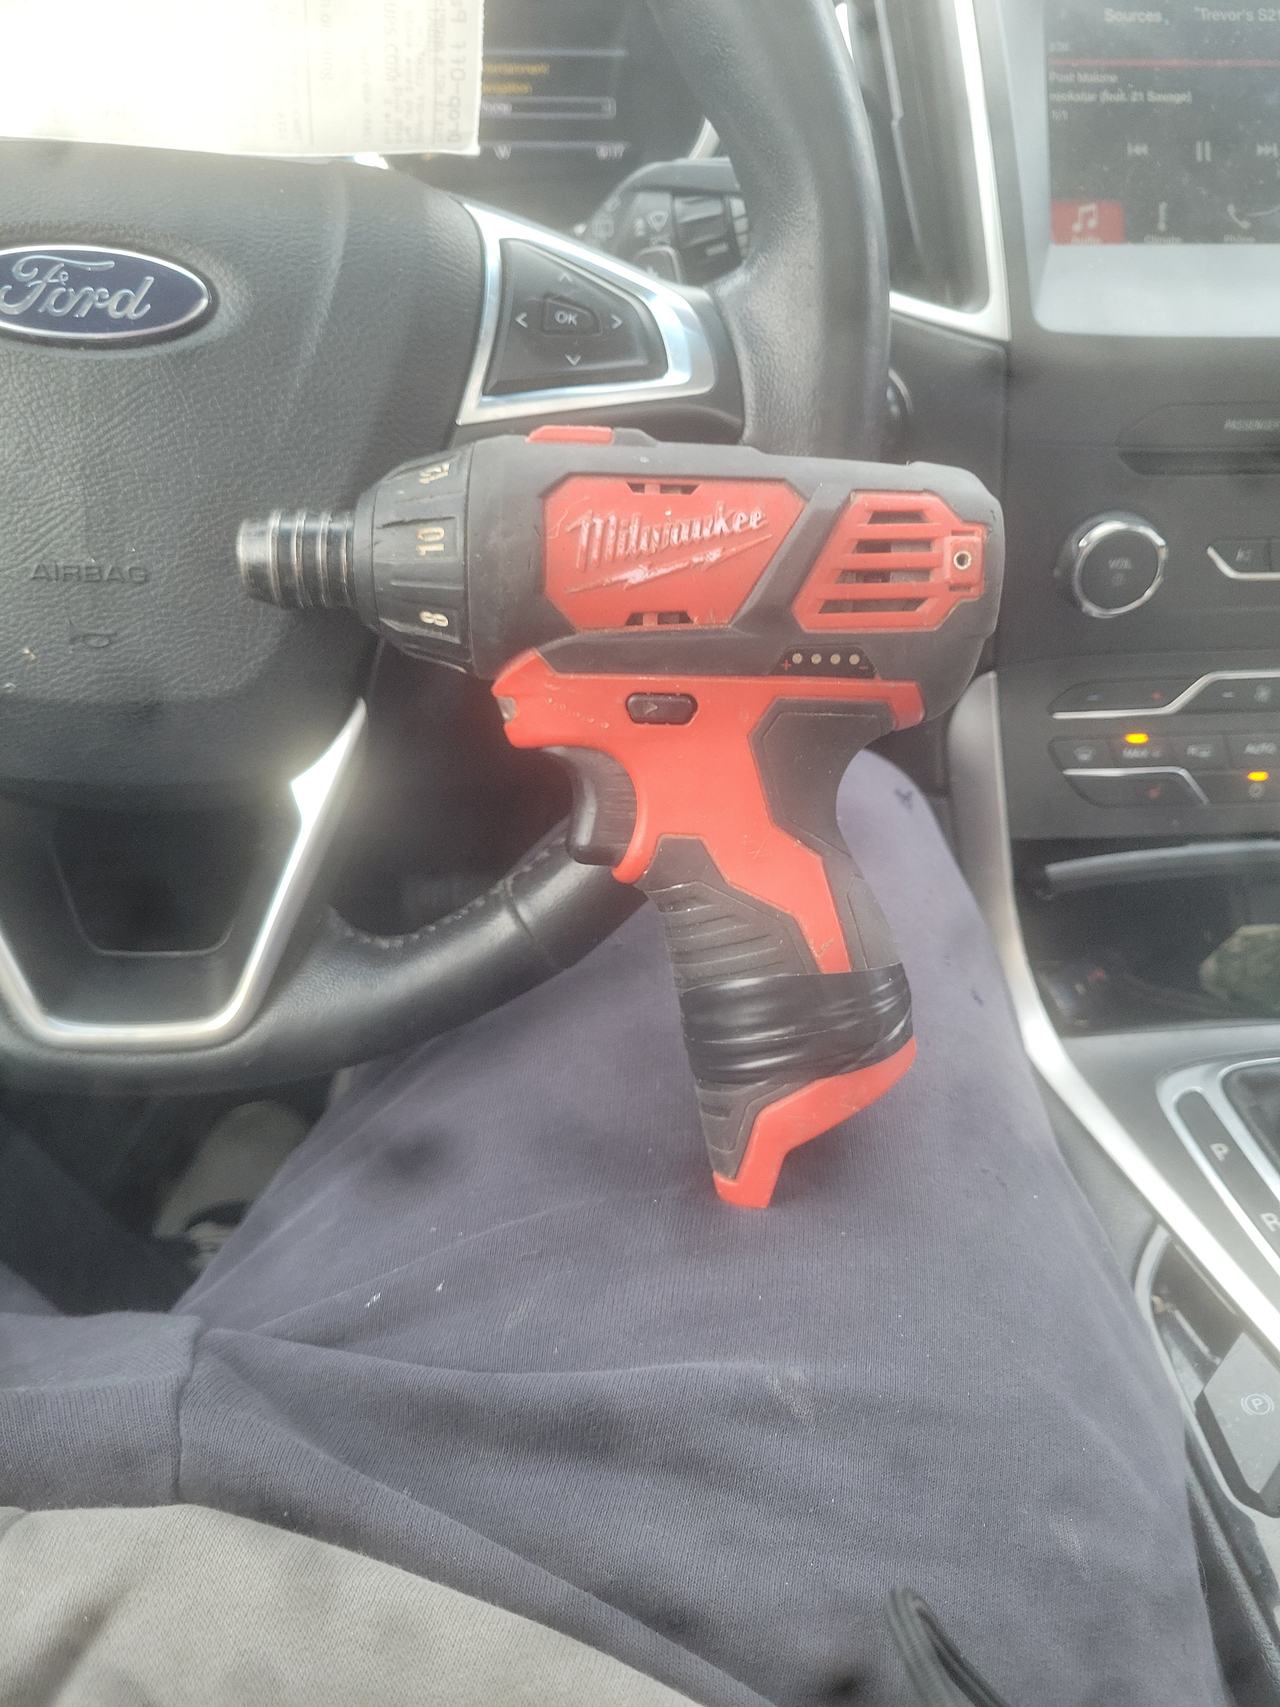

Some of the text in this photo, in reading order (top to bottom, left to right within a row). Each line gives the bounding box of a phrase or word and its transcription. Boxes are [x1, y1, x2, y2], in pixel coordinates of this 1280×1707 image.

[1103, 8, 1163, 24] Sources
[0, 255, 154, 321] Ford
[554, 310, 578, 326] OK
[416, 526, 446, 557] 10
[567, 501, 770, 572] Milwaukee
[30, 562, 149, 585] AIRBAG
[419, 610, 449, 628] 8
[1209, 1142, 1230, 1162] P
[1260, 1212, 1280, 1233] R
